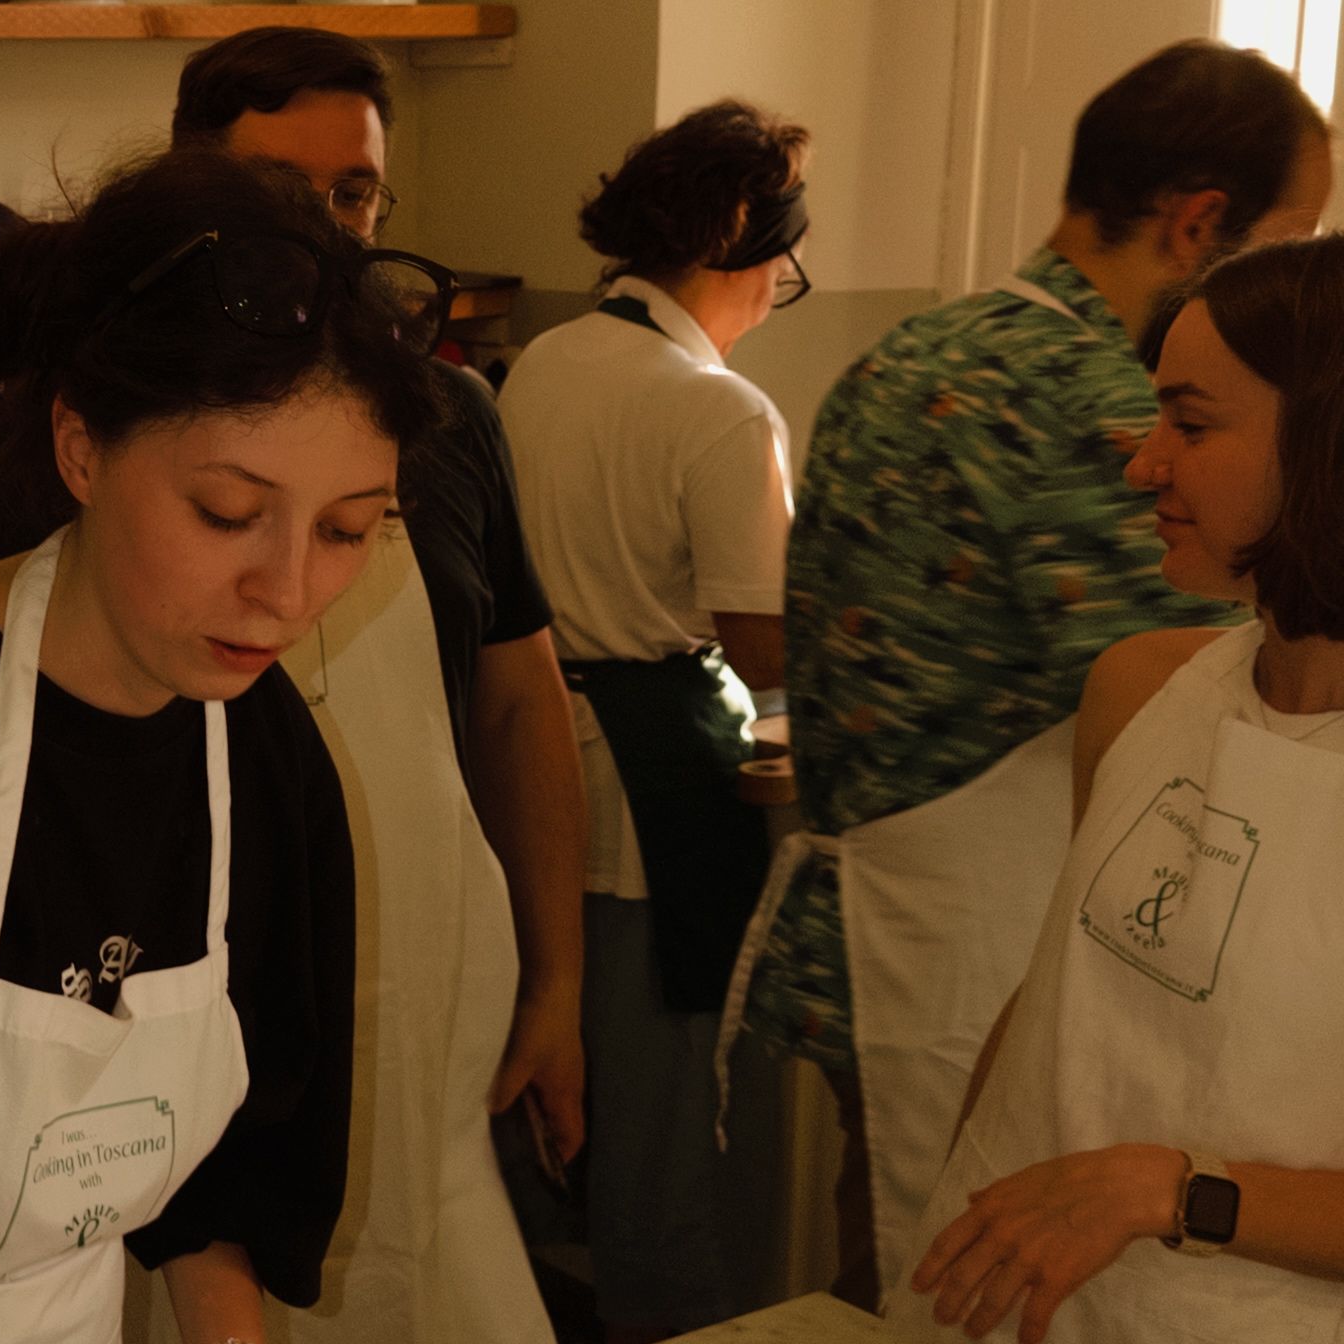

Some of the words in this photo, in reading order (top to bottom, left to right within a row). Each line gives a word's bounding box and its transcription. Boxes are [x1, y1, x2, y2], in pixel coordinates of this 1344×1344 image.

[76, 1148, 93, 1169] in
[92, 1135, 167, 1164] Toscana
[79, 1171, 103, 1190] with
[64, 1203, 121, 1237] Mauro
